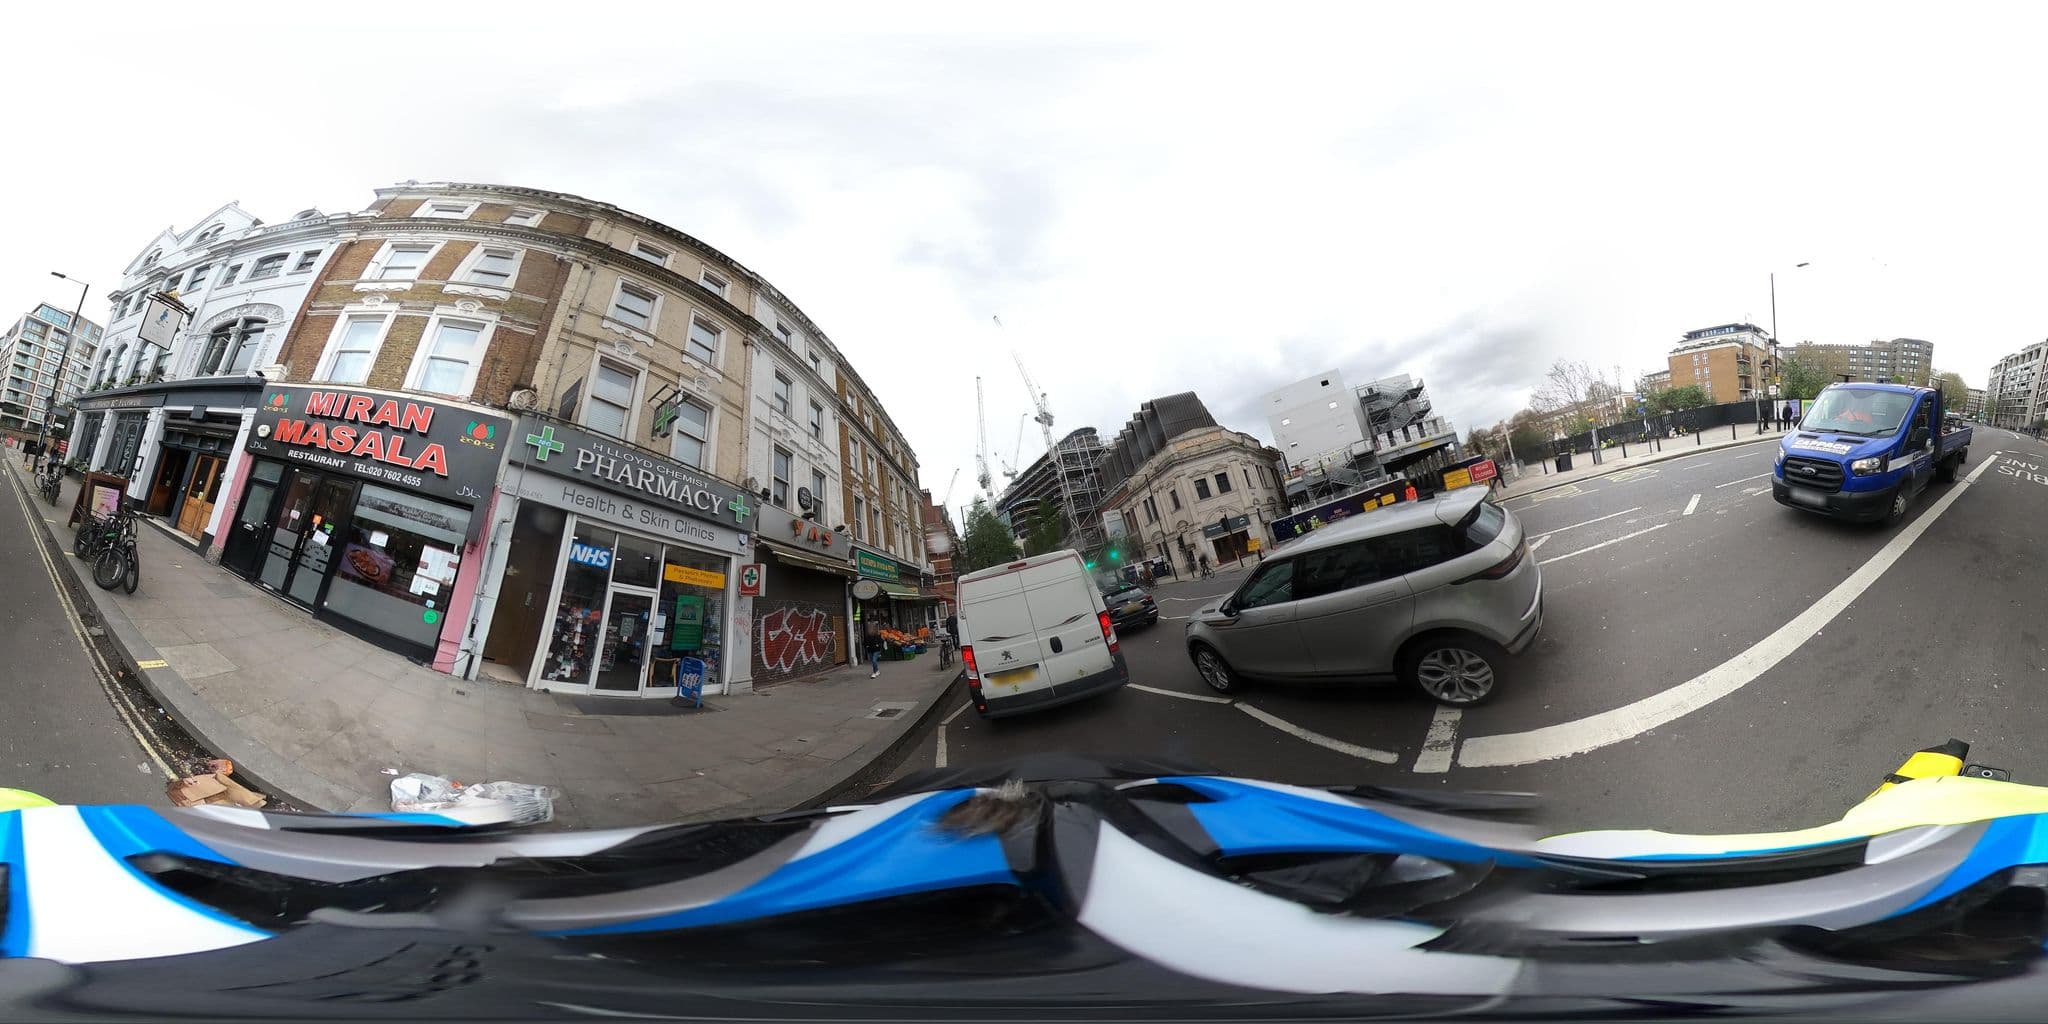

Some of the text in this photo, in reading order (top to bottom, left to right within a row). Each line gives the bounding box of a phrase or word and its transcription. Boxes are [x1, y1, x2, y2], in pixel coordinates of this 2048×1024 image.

[305, 391, 435, 434] MIRAN
[273, 418, 449, 477] MASALA
[592, 442, 709, 489] H LLOYD CHEMIST
[288, 449, 346, 468] RESTAURANT
[383, 469, 401, 482] 7602
[401, 474, 422, 487] 4555
[573, 448, 724, 516] PHARMACY
[1474, 469, 1493, 479] CLOSED
[1997, 465, 2048, 485] BUS
[562, 486, 716, 542] Health & Skin Clinics
[793, 519, 833, 547] YAS
[570, 543, 611, 567] NHS
